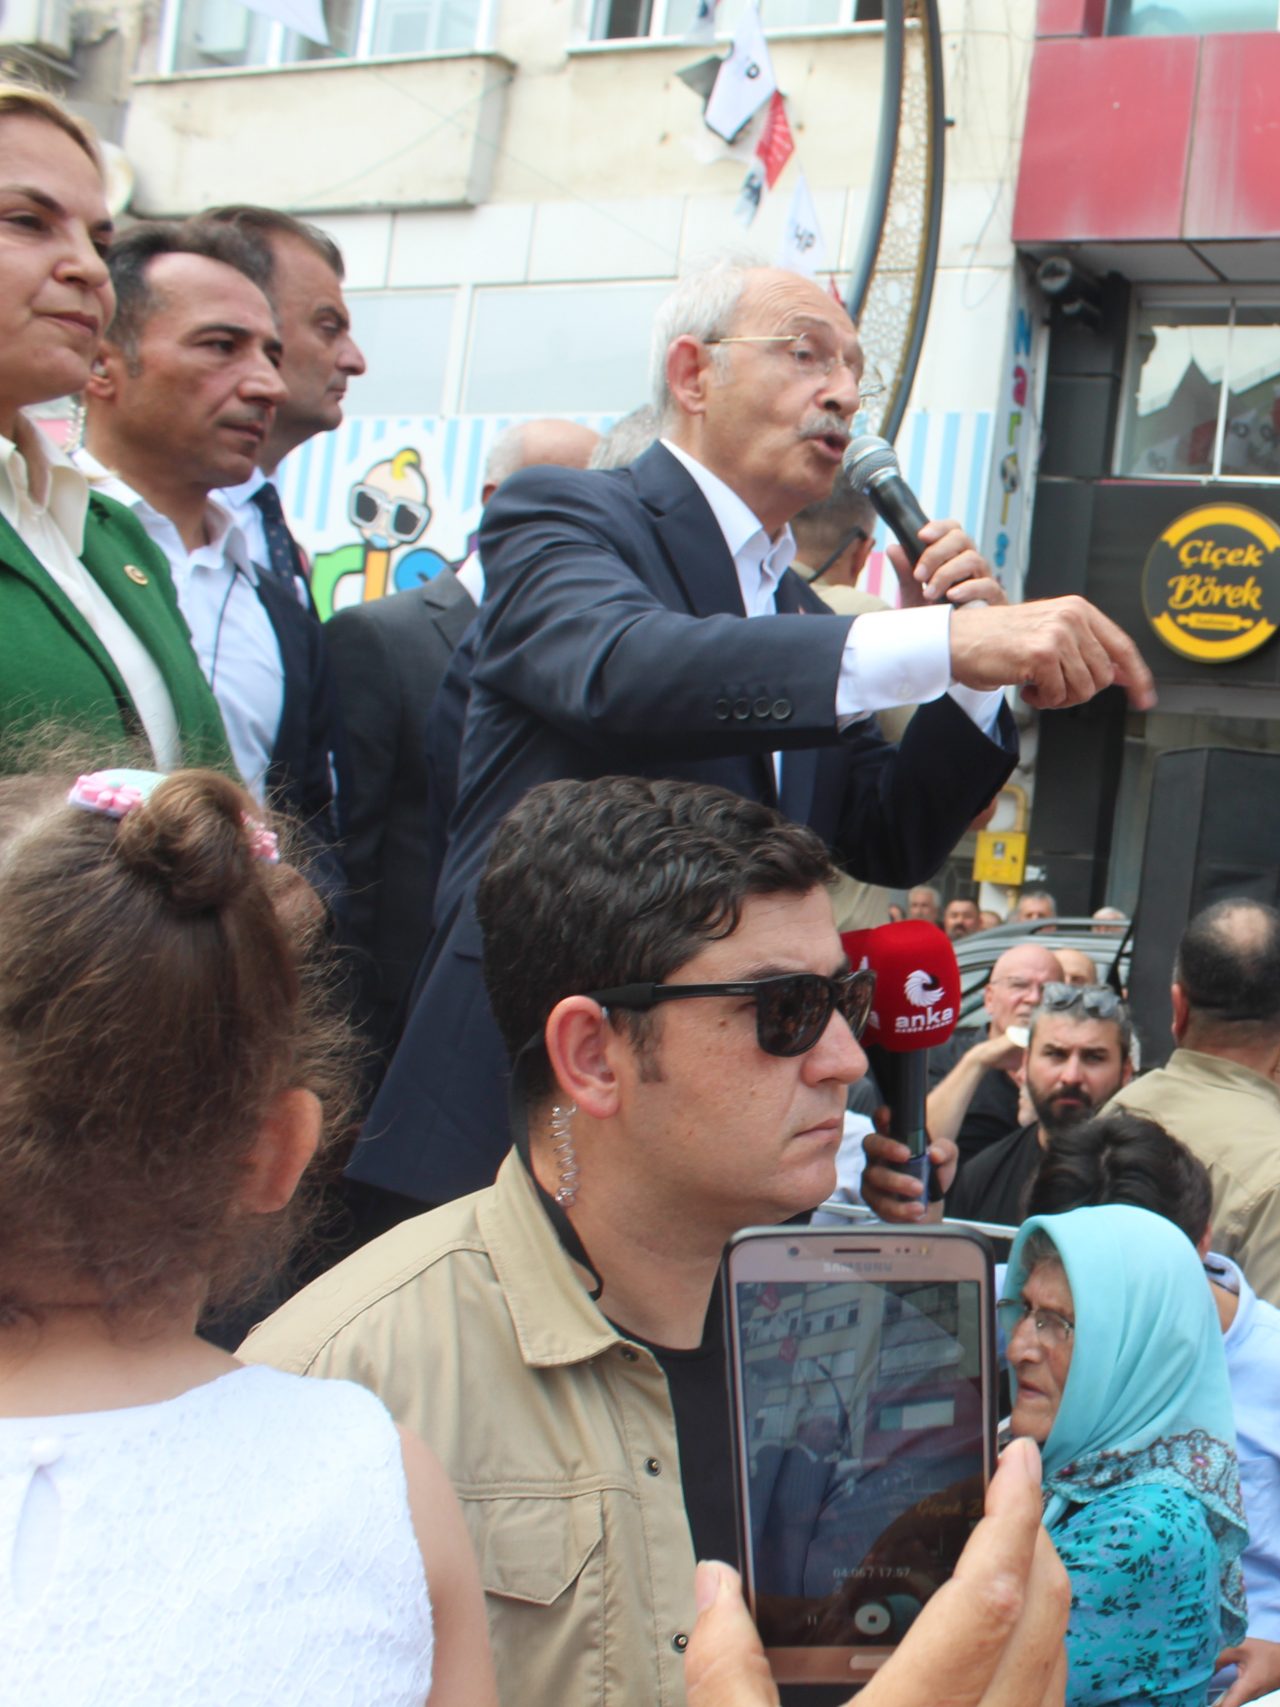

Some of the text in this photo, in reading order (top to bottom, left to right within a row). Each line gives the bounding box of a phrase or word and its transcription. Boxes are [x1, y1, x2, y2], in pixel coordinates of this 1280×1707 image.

[1178, 539, 1264, 570] Çiçek
[1167, 574, 1263, 611] Börek
[895, 1006, 954, 1028] anka
